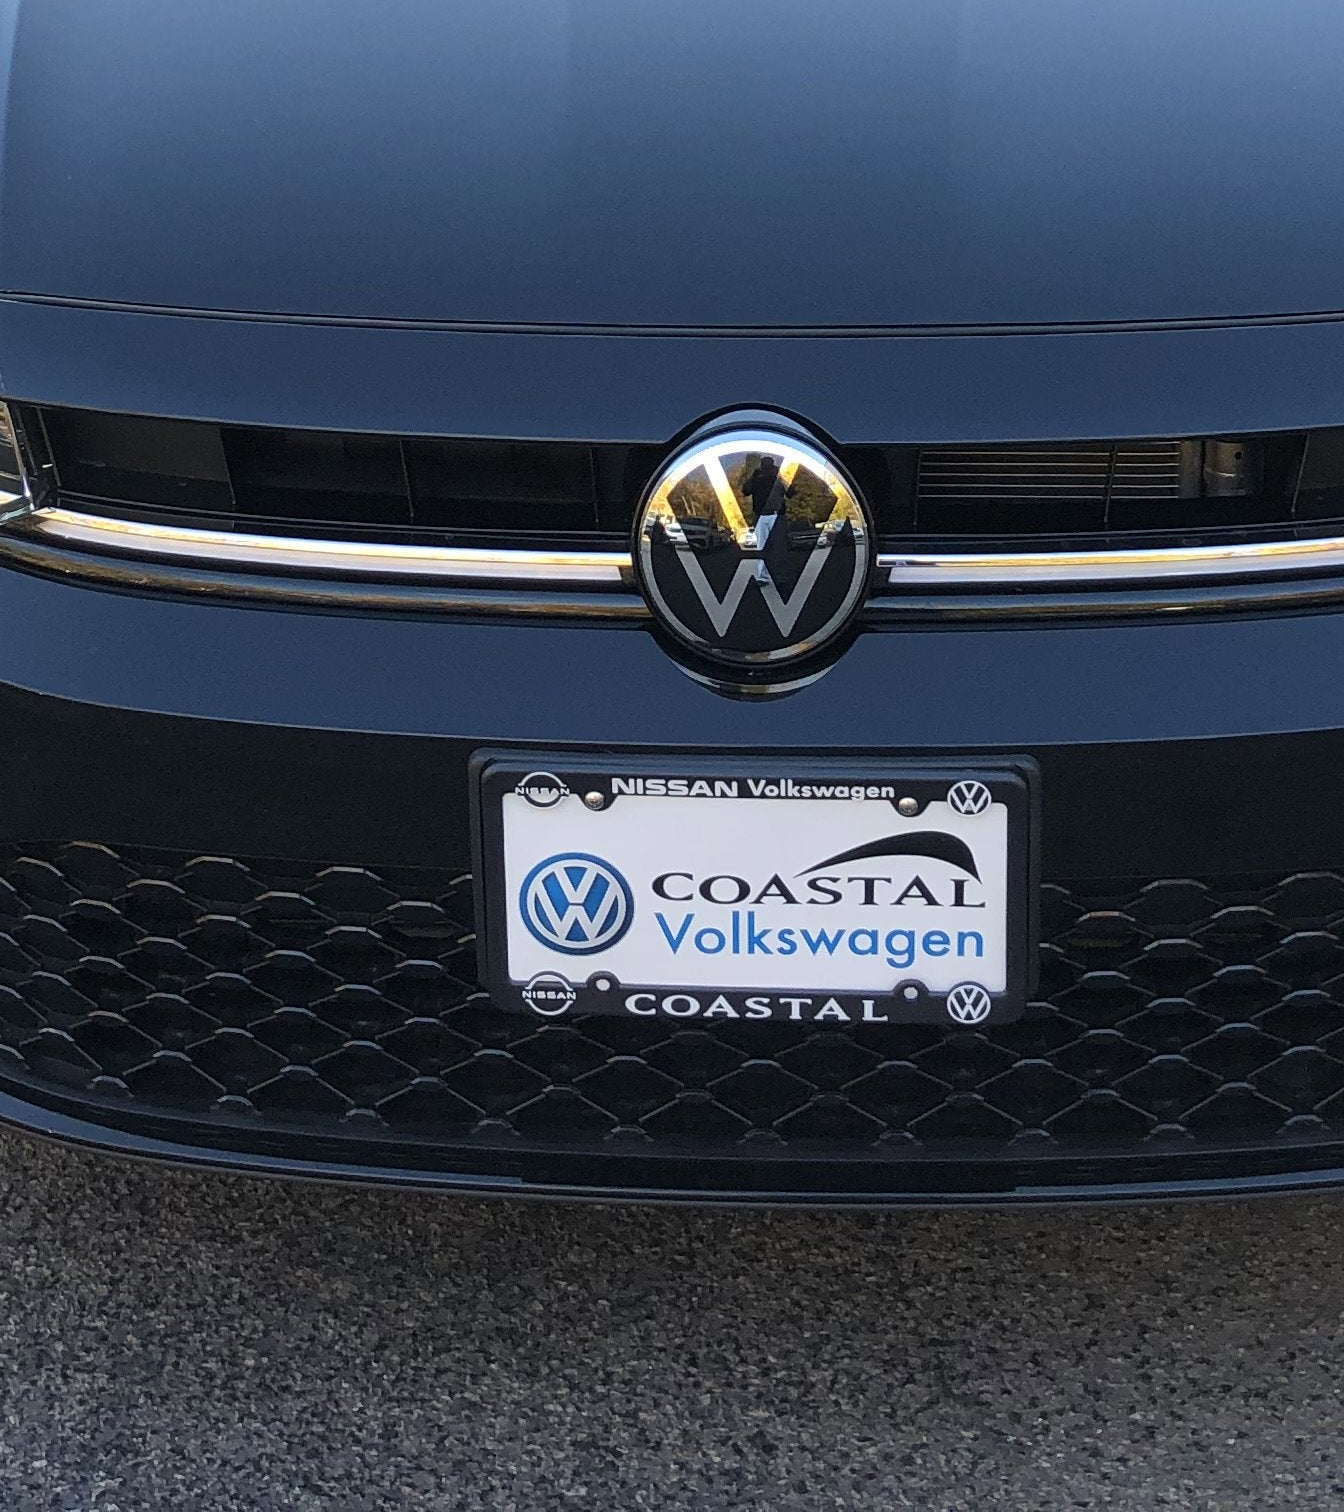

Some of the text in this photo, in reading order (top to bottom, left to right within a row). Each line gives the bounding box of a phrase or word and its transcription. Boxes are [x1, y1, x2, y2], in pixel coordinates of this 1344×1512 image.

[611, 777, 895, 801] NISSAN Volkswagen
[652, 872, 986, 908] COASTAL
[654, 910, 984, 968] Volkswagen
[522, 990, 576, 1000] NISSAN
[625, 994, 888, 1022] COASTAL
